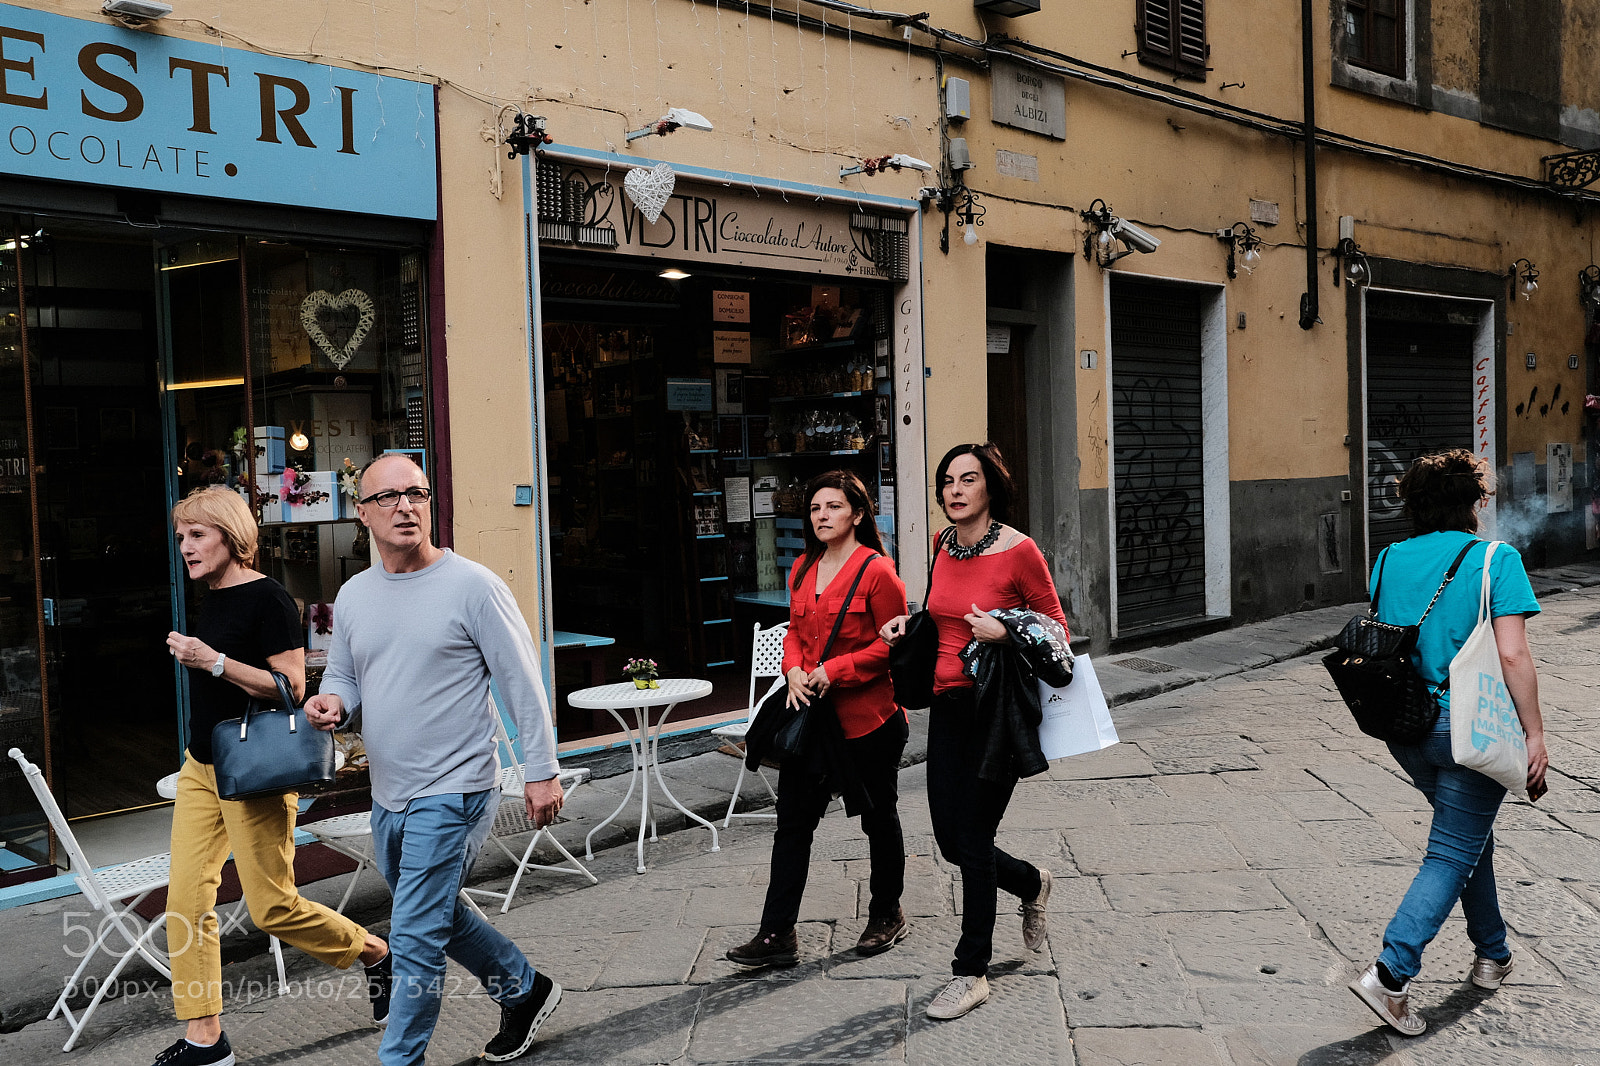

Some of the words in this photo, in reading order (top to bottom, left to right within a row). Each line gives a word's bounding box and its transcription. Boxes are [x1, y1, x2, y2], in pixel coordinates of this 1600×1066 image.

[1016, 72, 1043, 89] BORGO
[1021, 90, 1039, 102] DEGLI
[1014, 104, 1048, 123] ALBIZI
[9, 125, 211, 179] OCOLATE
[720, 211, 788, 247] Cioccolato
[791, 221, 849, 254] d'Autore
[900, 298, 912, 413] Gelato
